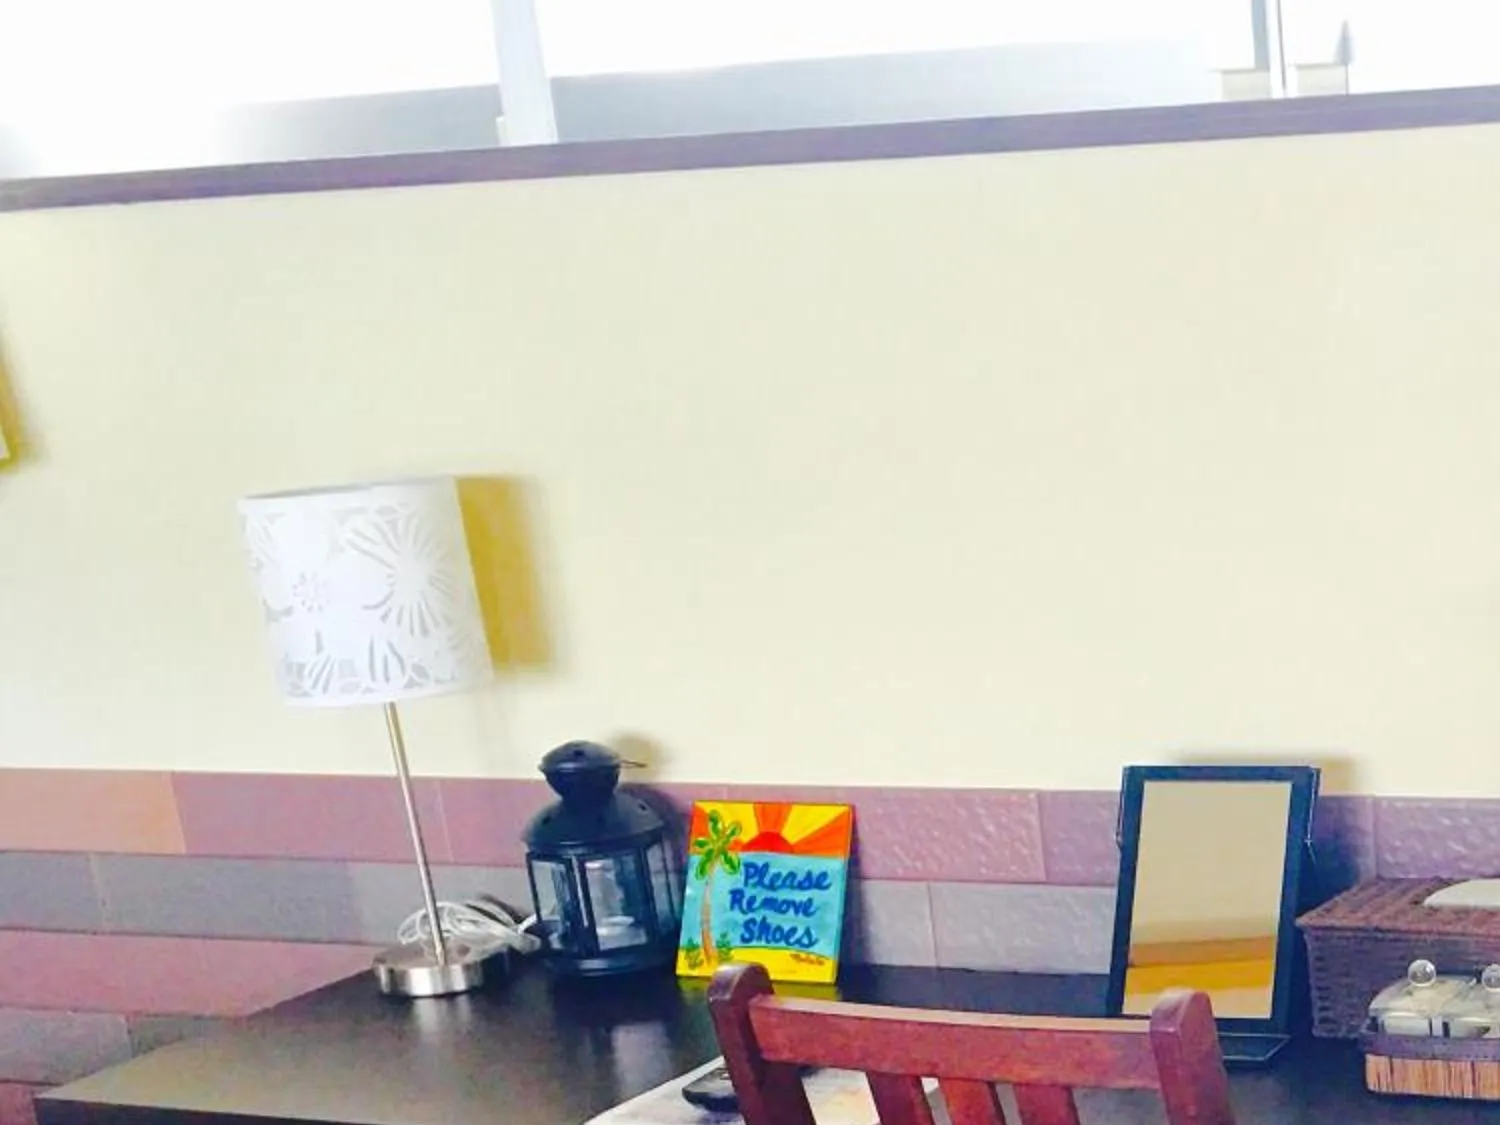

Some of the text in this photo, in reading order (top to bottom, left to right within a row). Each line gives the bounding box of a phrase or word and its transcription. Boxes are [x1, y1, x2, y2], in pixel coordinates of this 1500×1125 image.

[742, 861, 832, 891] Please
[728, 888, 817, 918] Remove
[739, 916, 819, 949] Shoes
